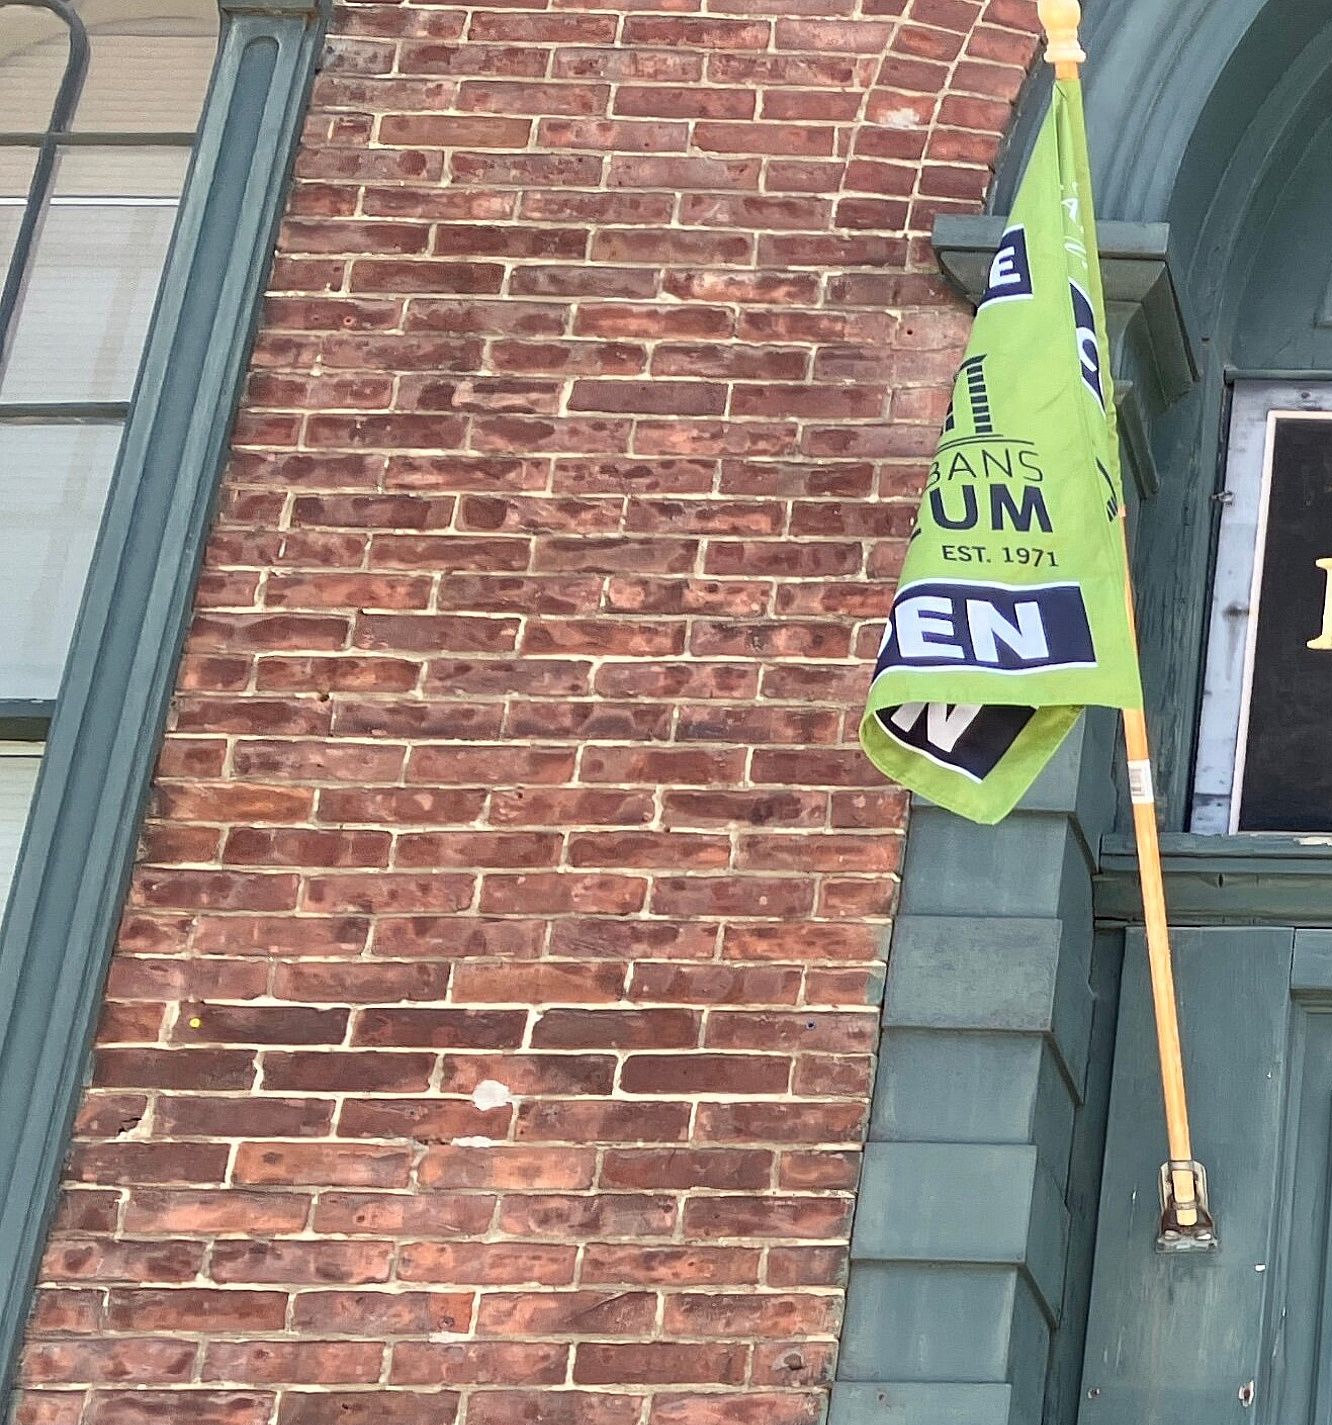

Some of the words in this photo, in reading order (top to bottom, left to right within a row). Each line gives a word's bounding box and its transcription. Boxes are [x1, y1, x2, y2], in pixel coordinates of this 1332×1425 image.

[910, 483, 1054, 541] UM
[942, 545, 991, 564] EST.
[1003, 547, 1060, 568] 1971
[877, 595, 1050, 664] EN
